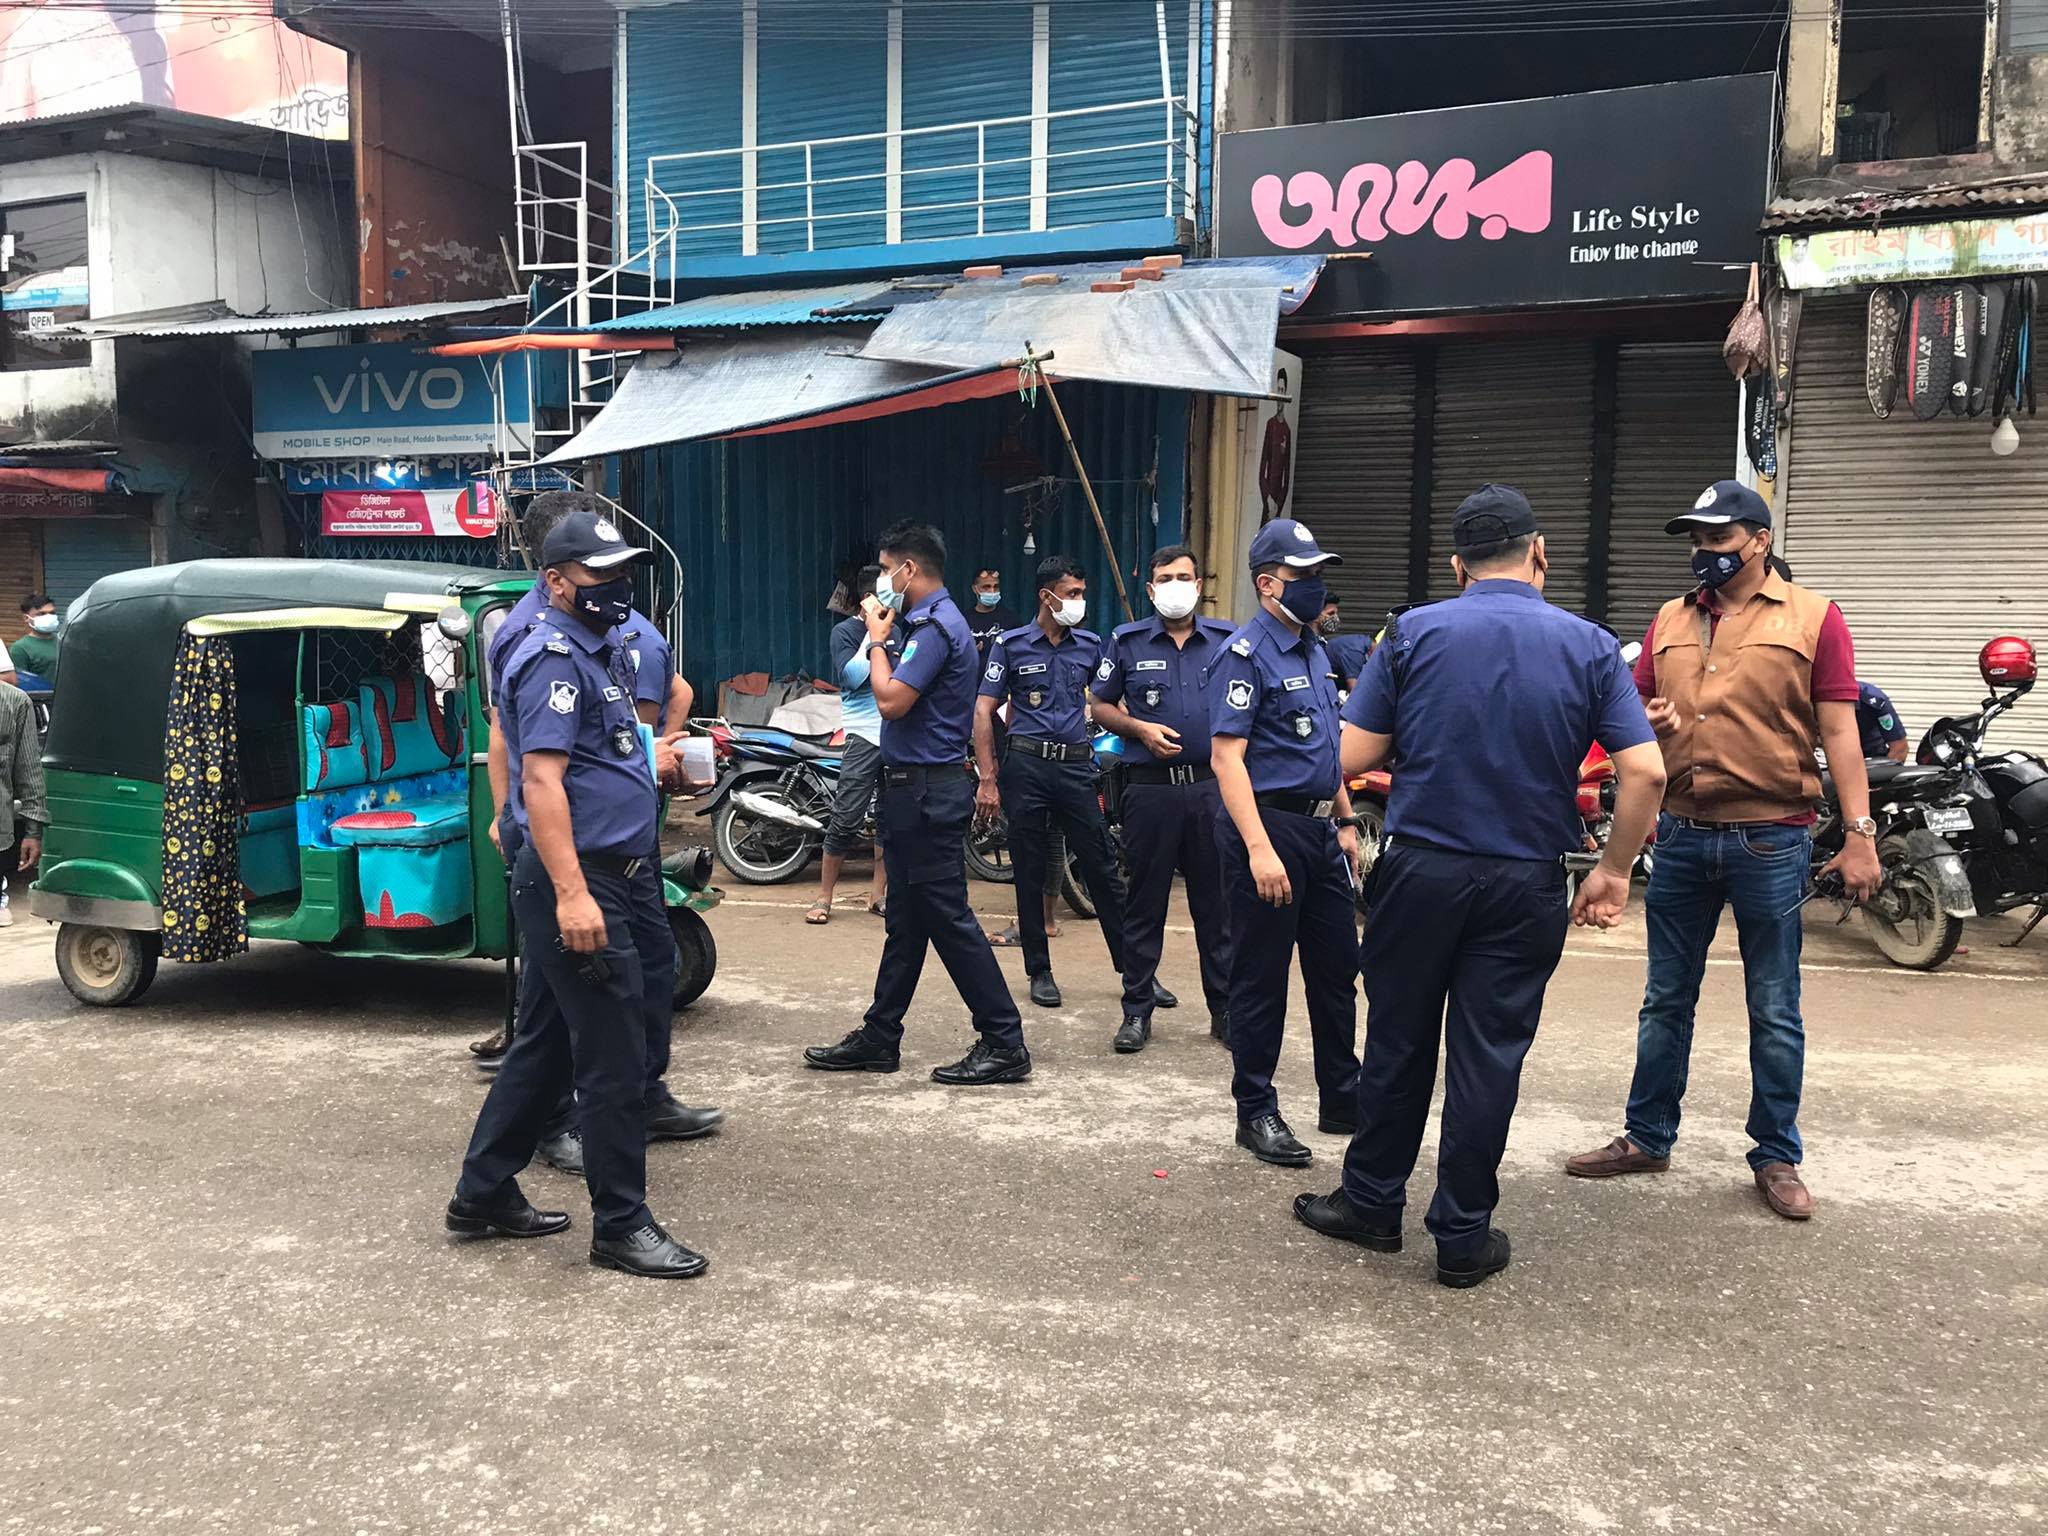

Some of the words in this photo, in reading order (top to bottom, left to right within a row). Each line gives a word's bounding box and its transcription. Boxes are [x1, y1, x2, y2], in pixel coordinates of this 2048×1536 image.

[1572, 208, 1623, 234] Life
[1631, 201, 1701, 234] Style
[1570, 243, 1612, 264] Enjoy
[1614, 242, 1639, 261] the
[1642, 238, 1699, 259] change
[31, 316, 52, 329] OPEN
[312, 357, 465, 415] vivo
[1915, 358, 1931, 395] YONEX
[1753, 396, 1765, 425] YONEX
[283, 438, 331, 449] MOBILE
[334, 435, 371, 447] SHOP
[376, 436, 393, 445] Main
[465, 518, 495, 526] WALTON
